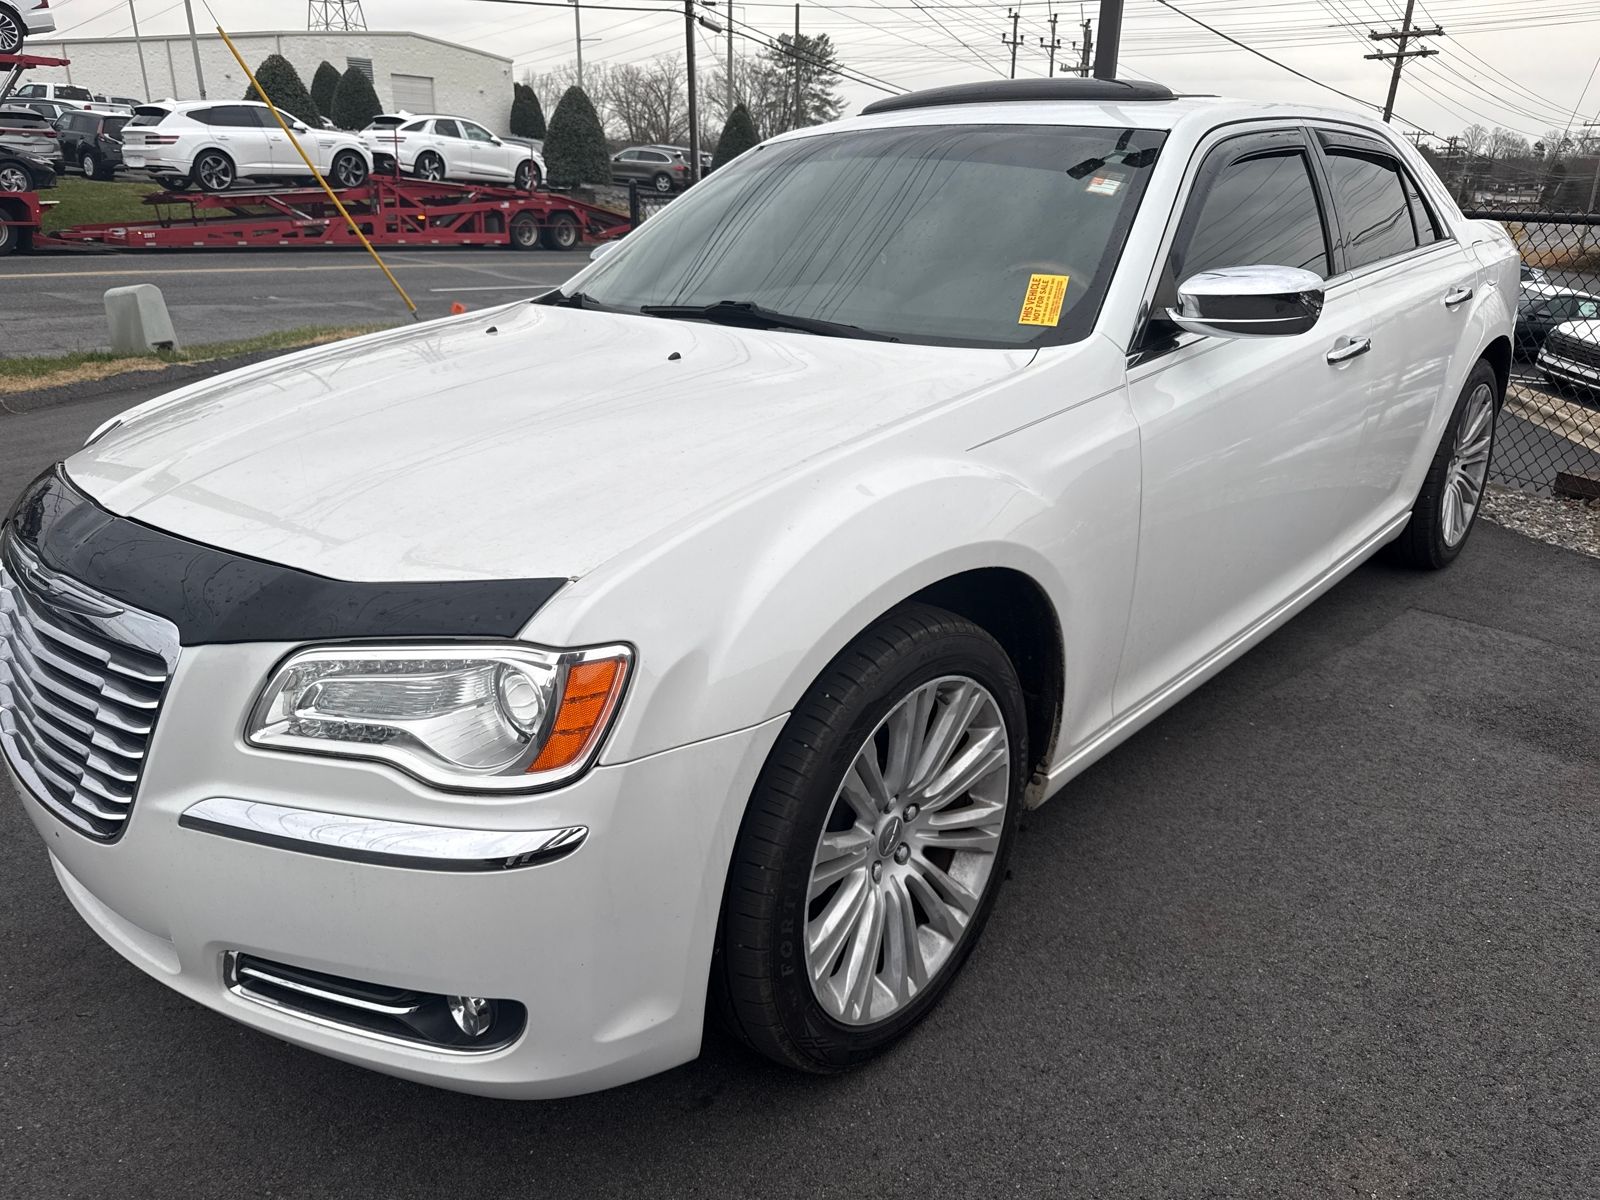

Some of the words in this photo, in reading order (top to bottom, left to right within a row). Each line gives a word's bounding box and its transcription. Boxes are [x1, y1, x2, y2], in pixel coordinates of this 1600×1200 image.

[1026, 278, 1041, 305] VEHICLE
[1040, 280, 1049, 294] SALE
[1036, 296, 1045, 308] FOR
[1021, 307, 1033, 321] THIS
[1032, 309, 1041, 321] NOT
